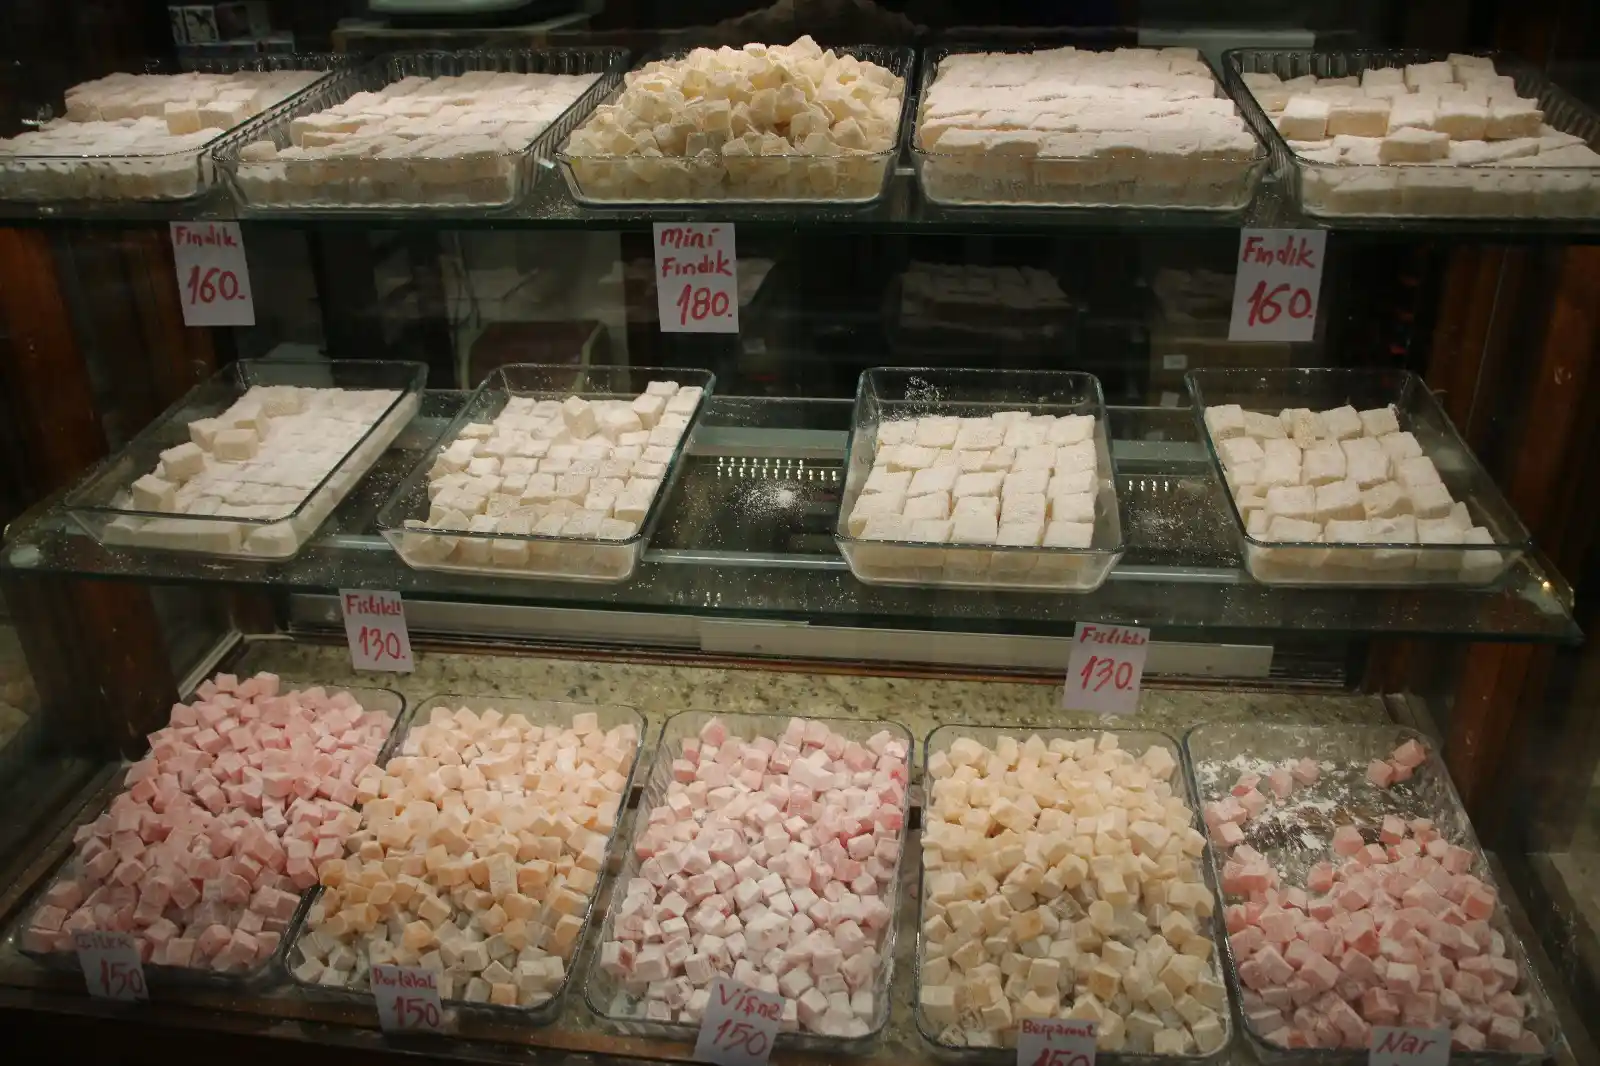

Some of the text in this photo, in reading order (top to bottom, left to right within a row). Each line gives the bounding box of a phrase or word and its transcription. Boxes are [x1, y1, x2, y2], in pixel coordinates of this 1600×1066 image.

[100, 957, 144, 997] 150
[392, 996, 440, 1029] 150
[712, 1019, 768, 1056] 150
[1375, 1031, 1437, 1055] Nar
